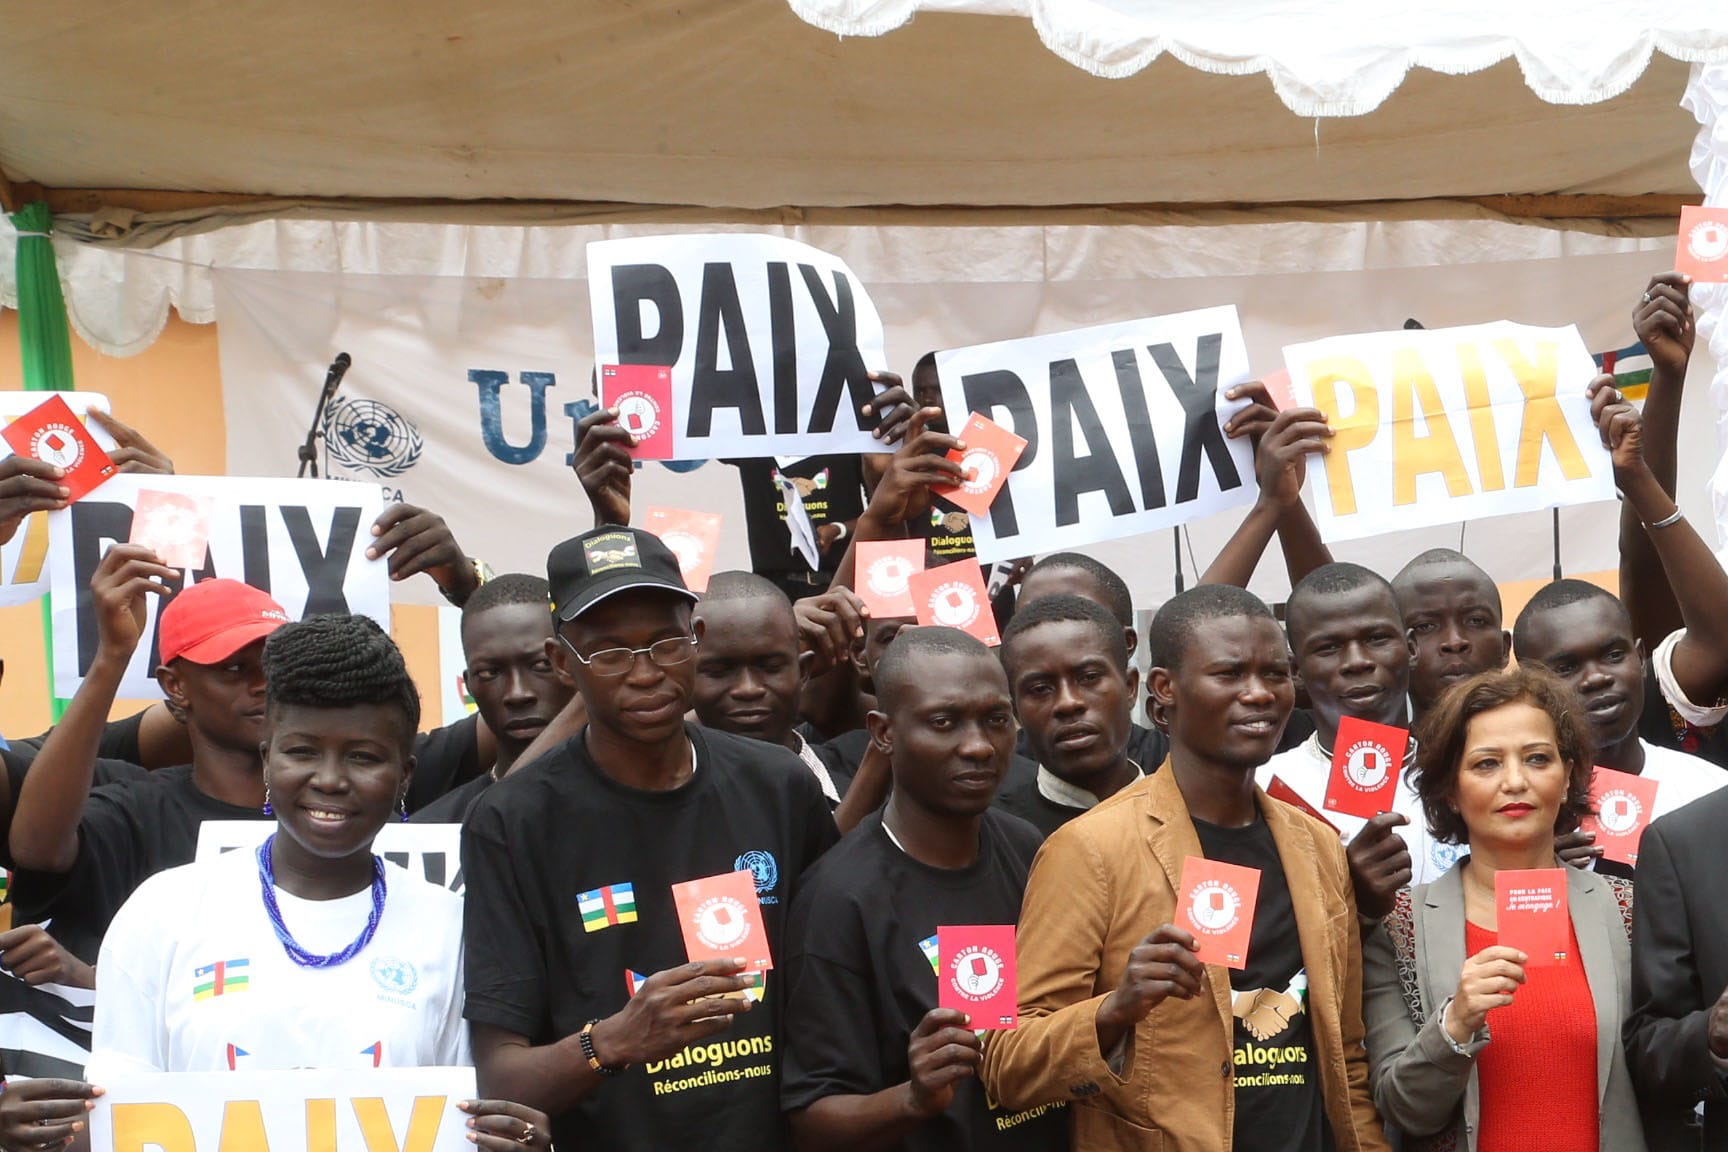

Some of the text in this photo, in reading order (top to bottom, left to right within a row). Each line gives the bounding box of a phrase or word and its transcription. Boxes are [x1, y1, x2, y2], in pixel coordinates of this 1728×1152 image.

[611, 262, 875, 437] PAIX
[961, 332, 1241, 538] PAIX
[1305, 335, 1591, 517] PAIX
[1344, 740, 1392, 767] CARTON ROUGE
[1342, 764, 1356, 788] CONTRE
[1364, 775, 1390, 792] VIOLENCE
[1188, 880, 1219, 899] CARTON
[950, 945, 1004, 969] CARTON ROUGE
[950, 977, 970, 999] CONTRE
[980, 977, 1005, 1001] VIOLENCE
[653, 1064, 772, 1095] Réconcilions-nous
